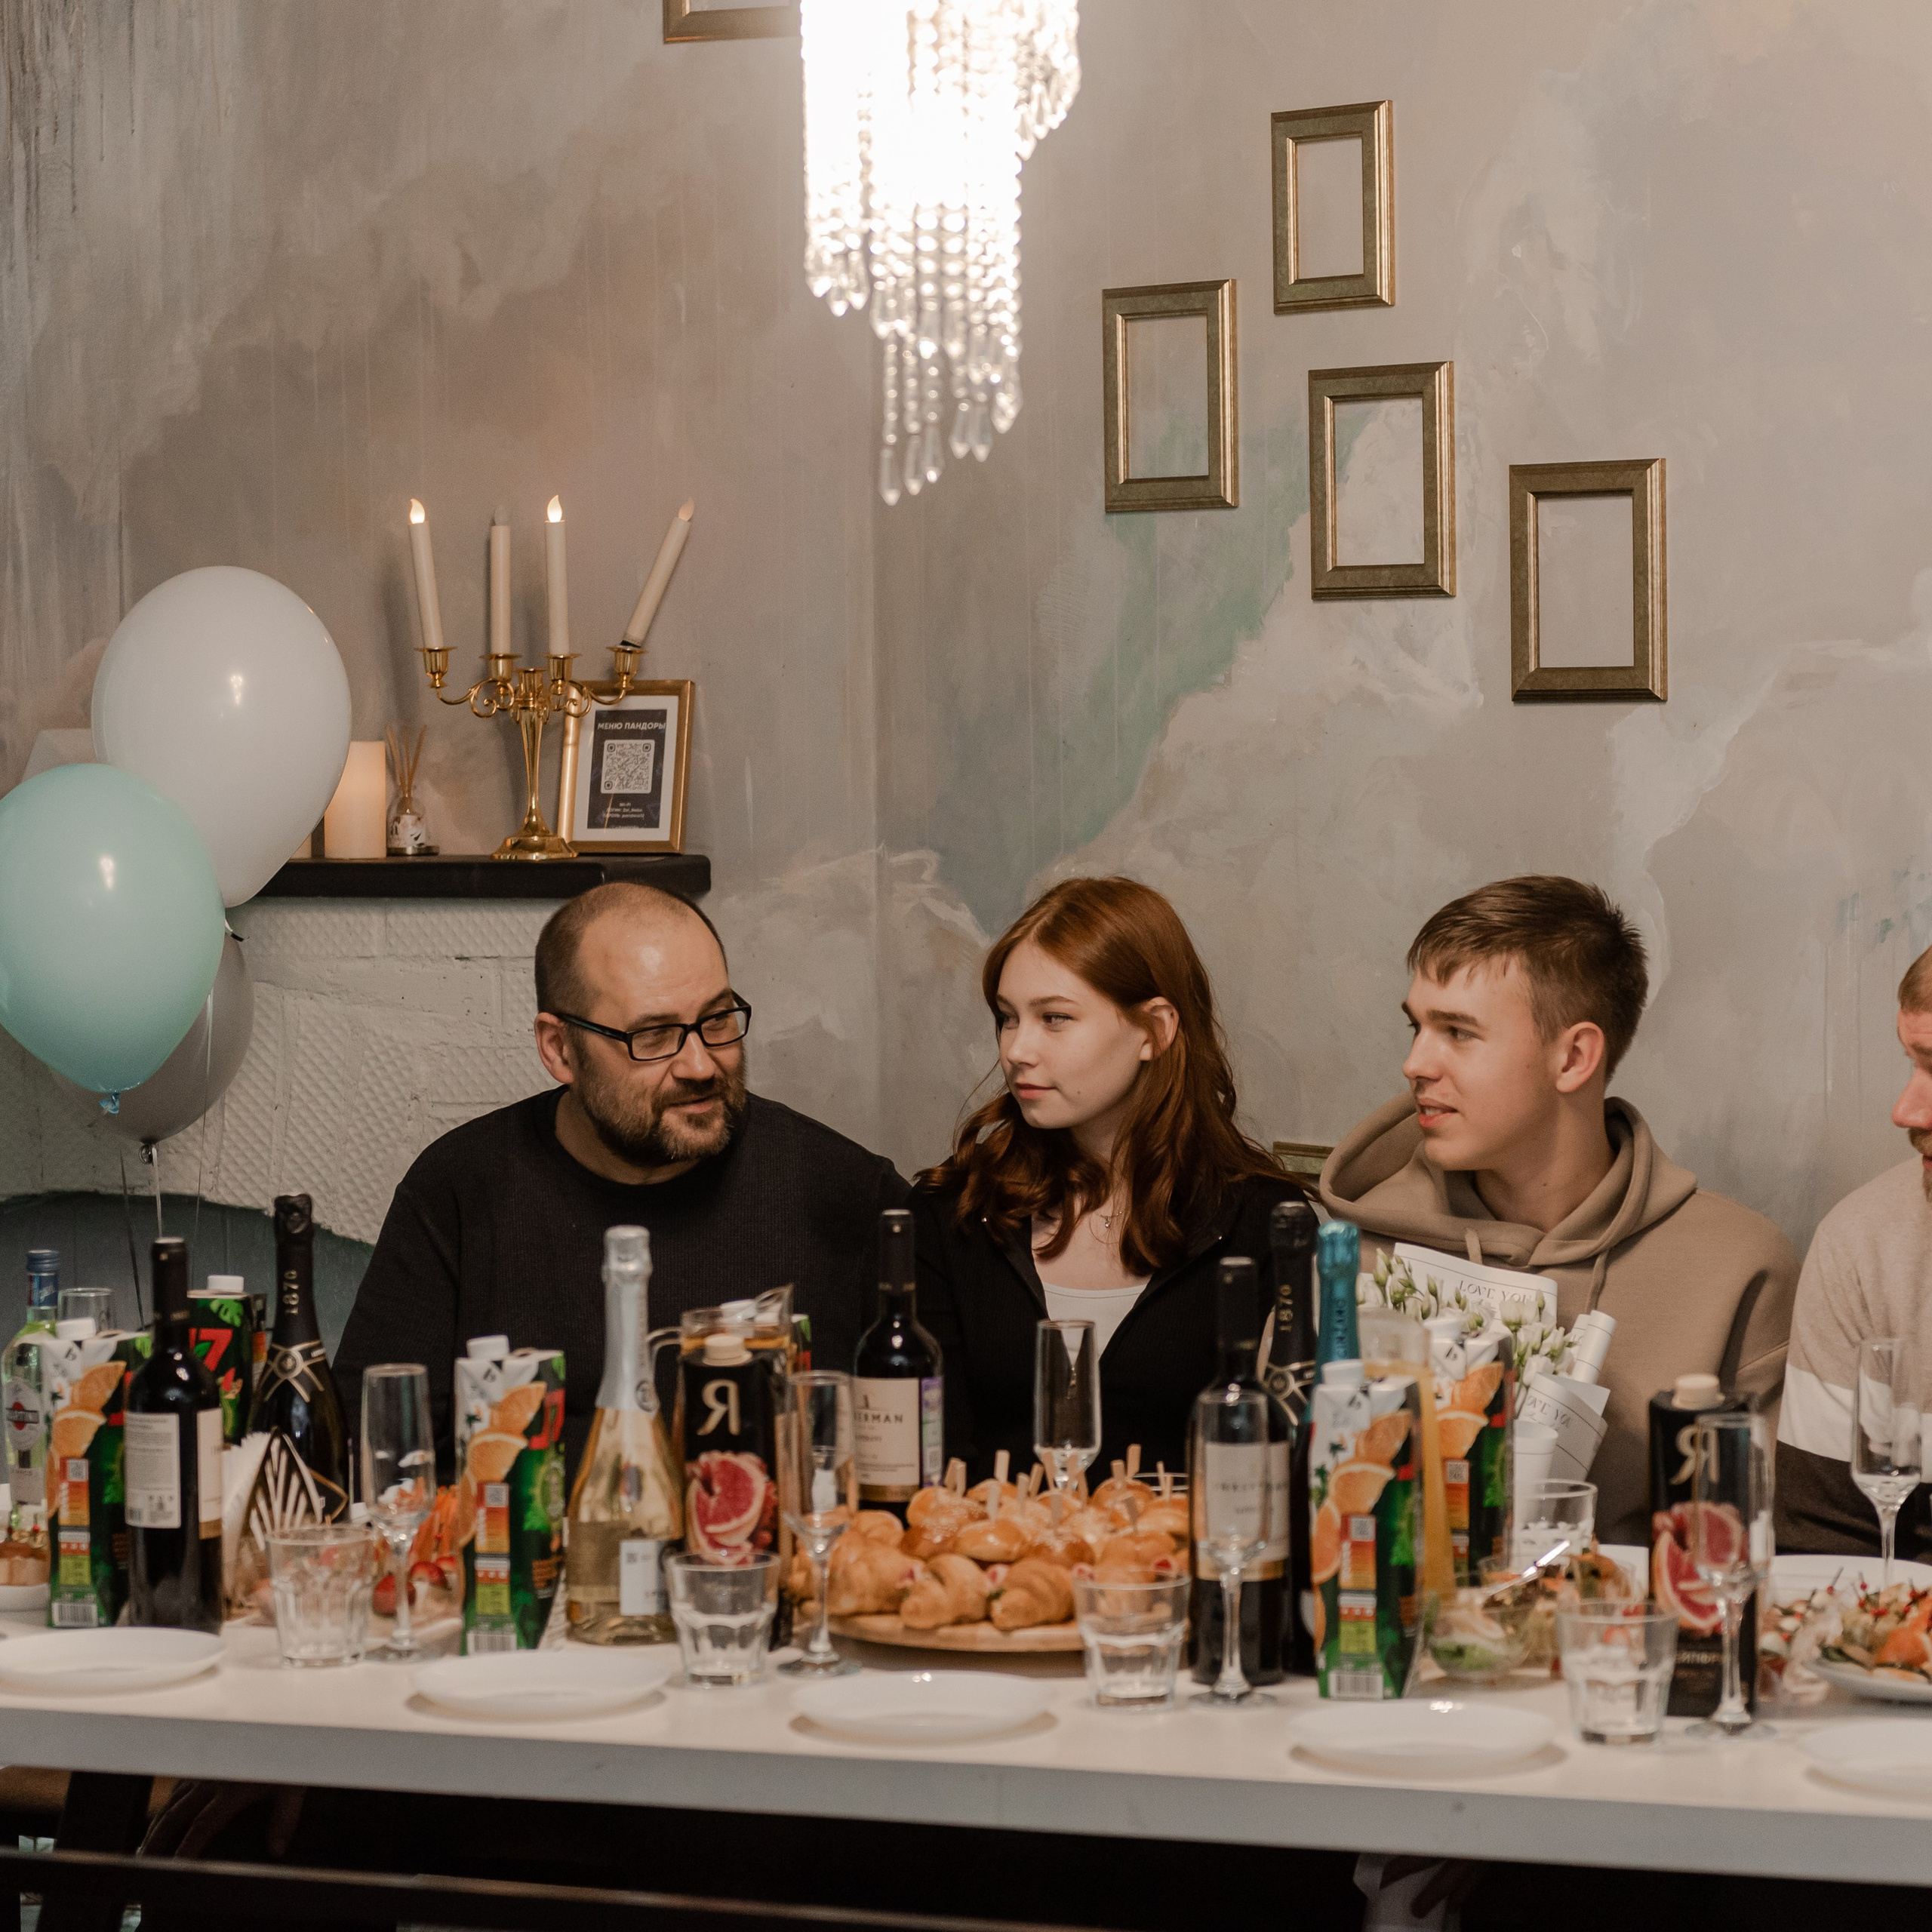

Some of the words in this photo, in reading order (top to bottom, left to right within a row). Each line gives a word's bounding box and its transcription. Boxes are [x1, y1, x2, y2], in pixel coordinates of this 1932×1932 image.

[624, 722, 666, 731] ПАНДОРЫ
[283, 1269, 299, 1315] 1870
[1459, 1279, 1496, 1299] LOVE
[1278, 1284, 1294, 1331] 1870
[854, 1412, 904, 1423] ERMAN
